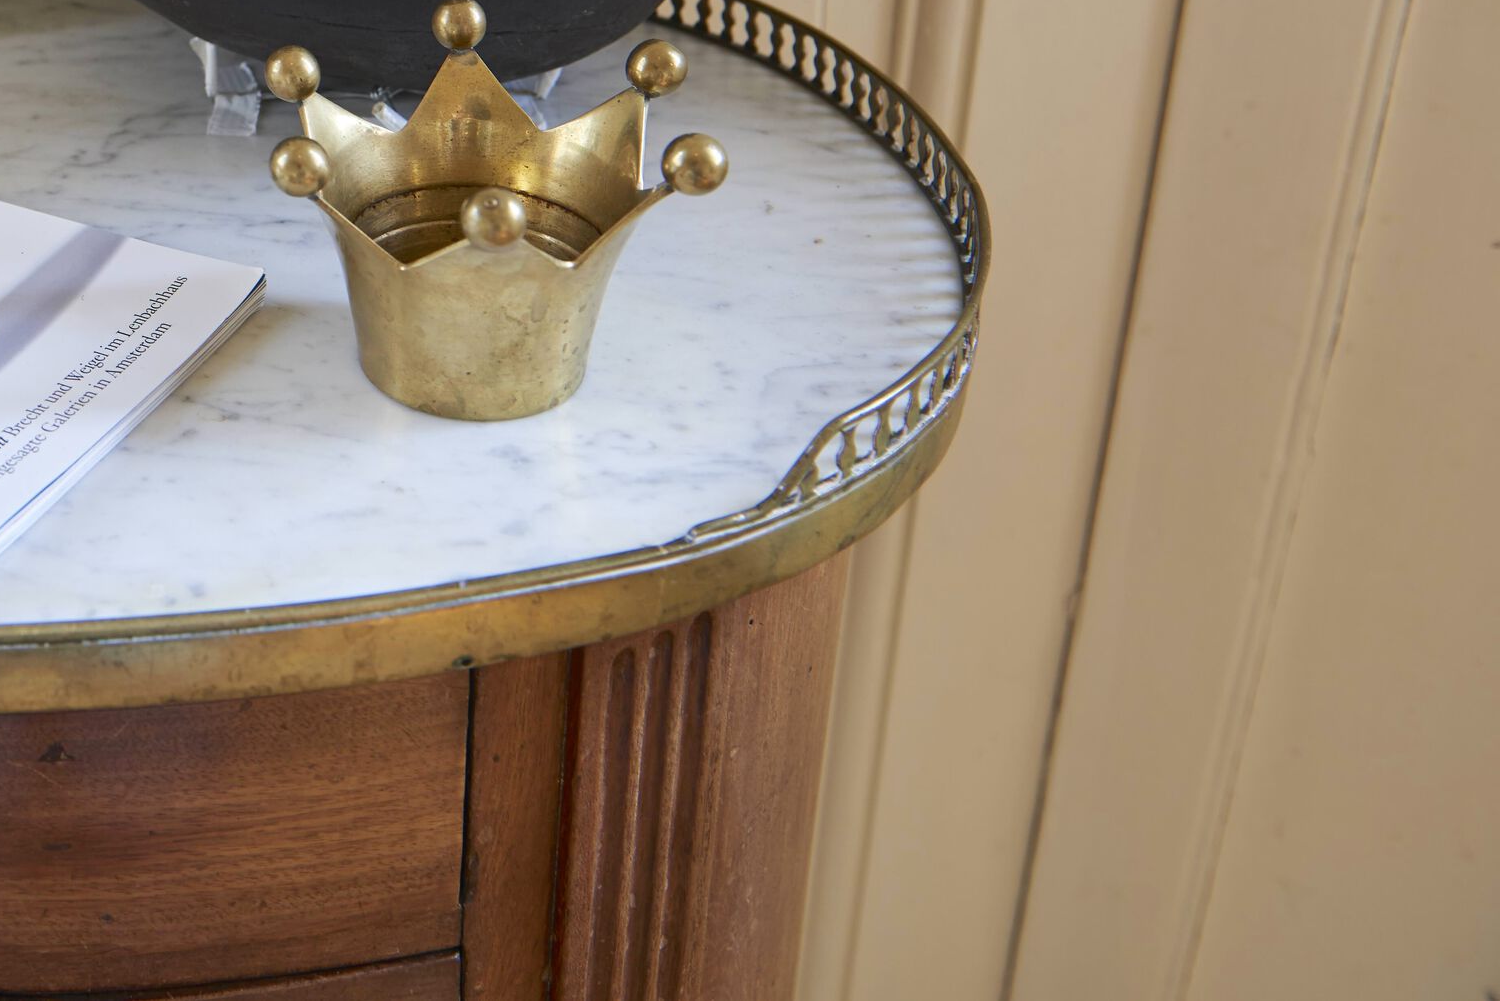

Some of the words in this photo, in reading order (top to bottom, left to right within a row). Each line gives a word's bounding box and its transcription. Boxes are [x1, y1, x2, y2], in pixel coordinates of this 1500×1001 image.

[2, 403, 50, 437] Brecht
[45, 382, 73, 404] und
[64, 349, 109, 382] Weigel
[100, 337, 126, 353] im
[116, 275, 188, 339] Lenbachhaus
[41, 389, 97, 433] Galerien
[88, 378, 111, 392] in
[105, 321, 173, 379] Amsterdam
